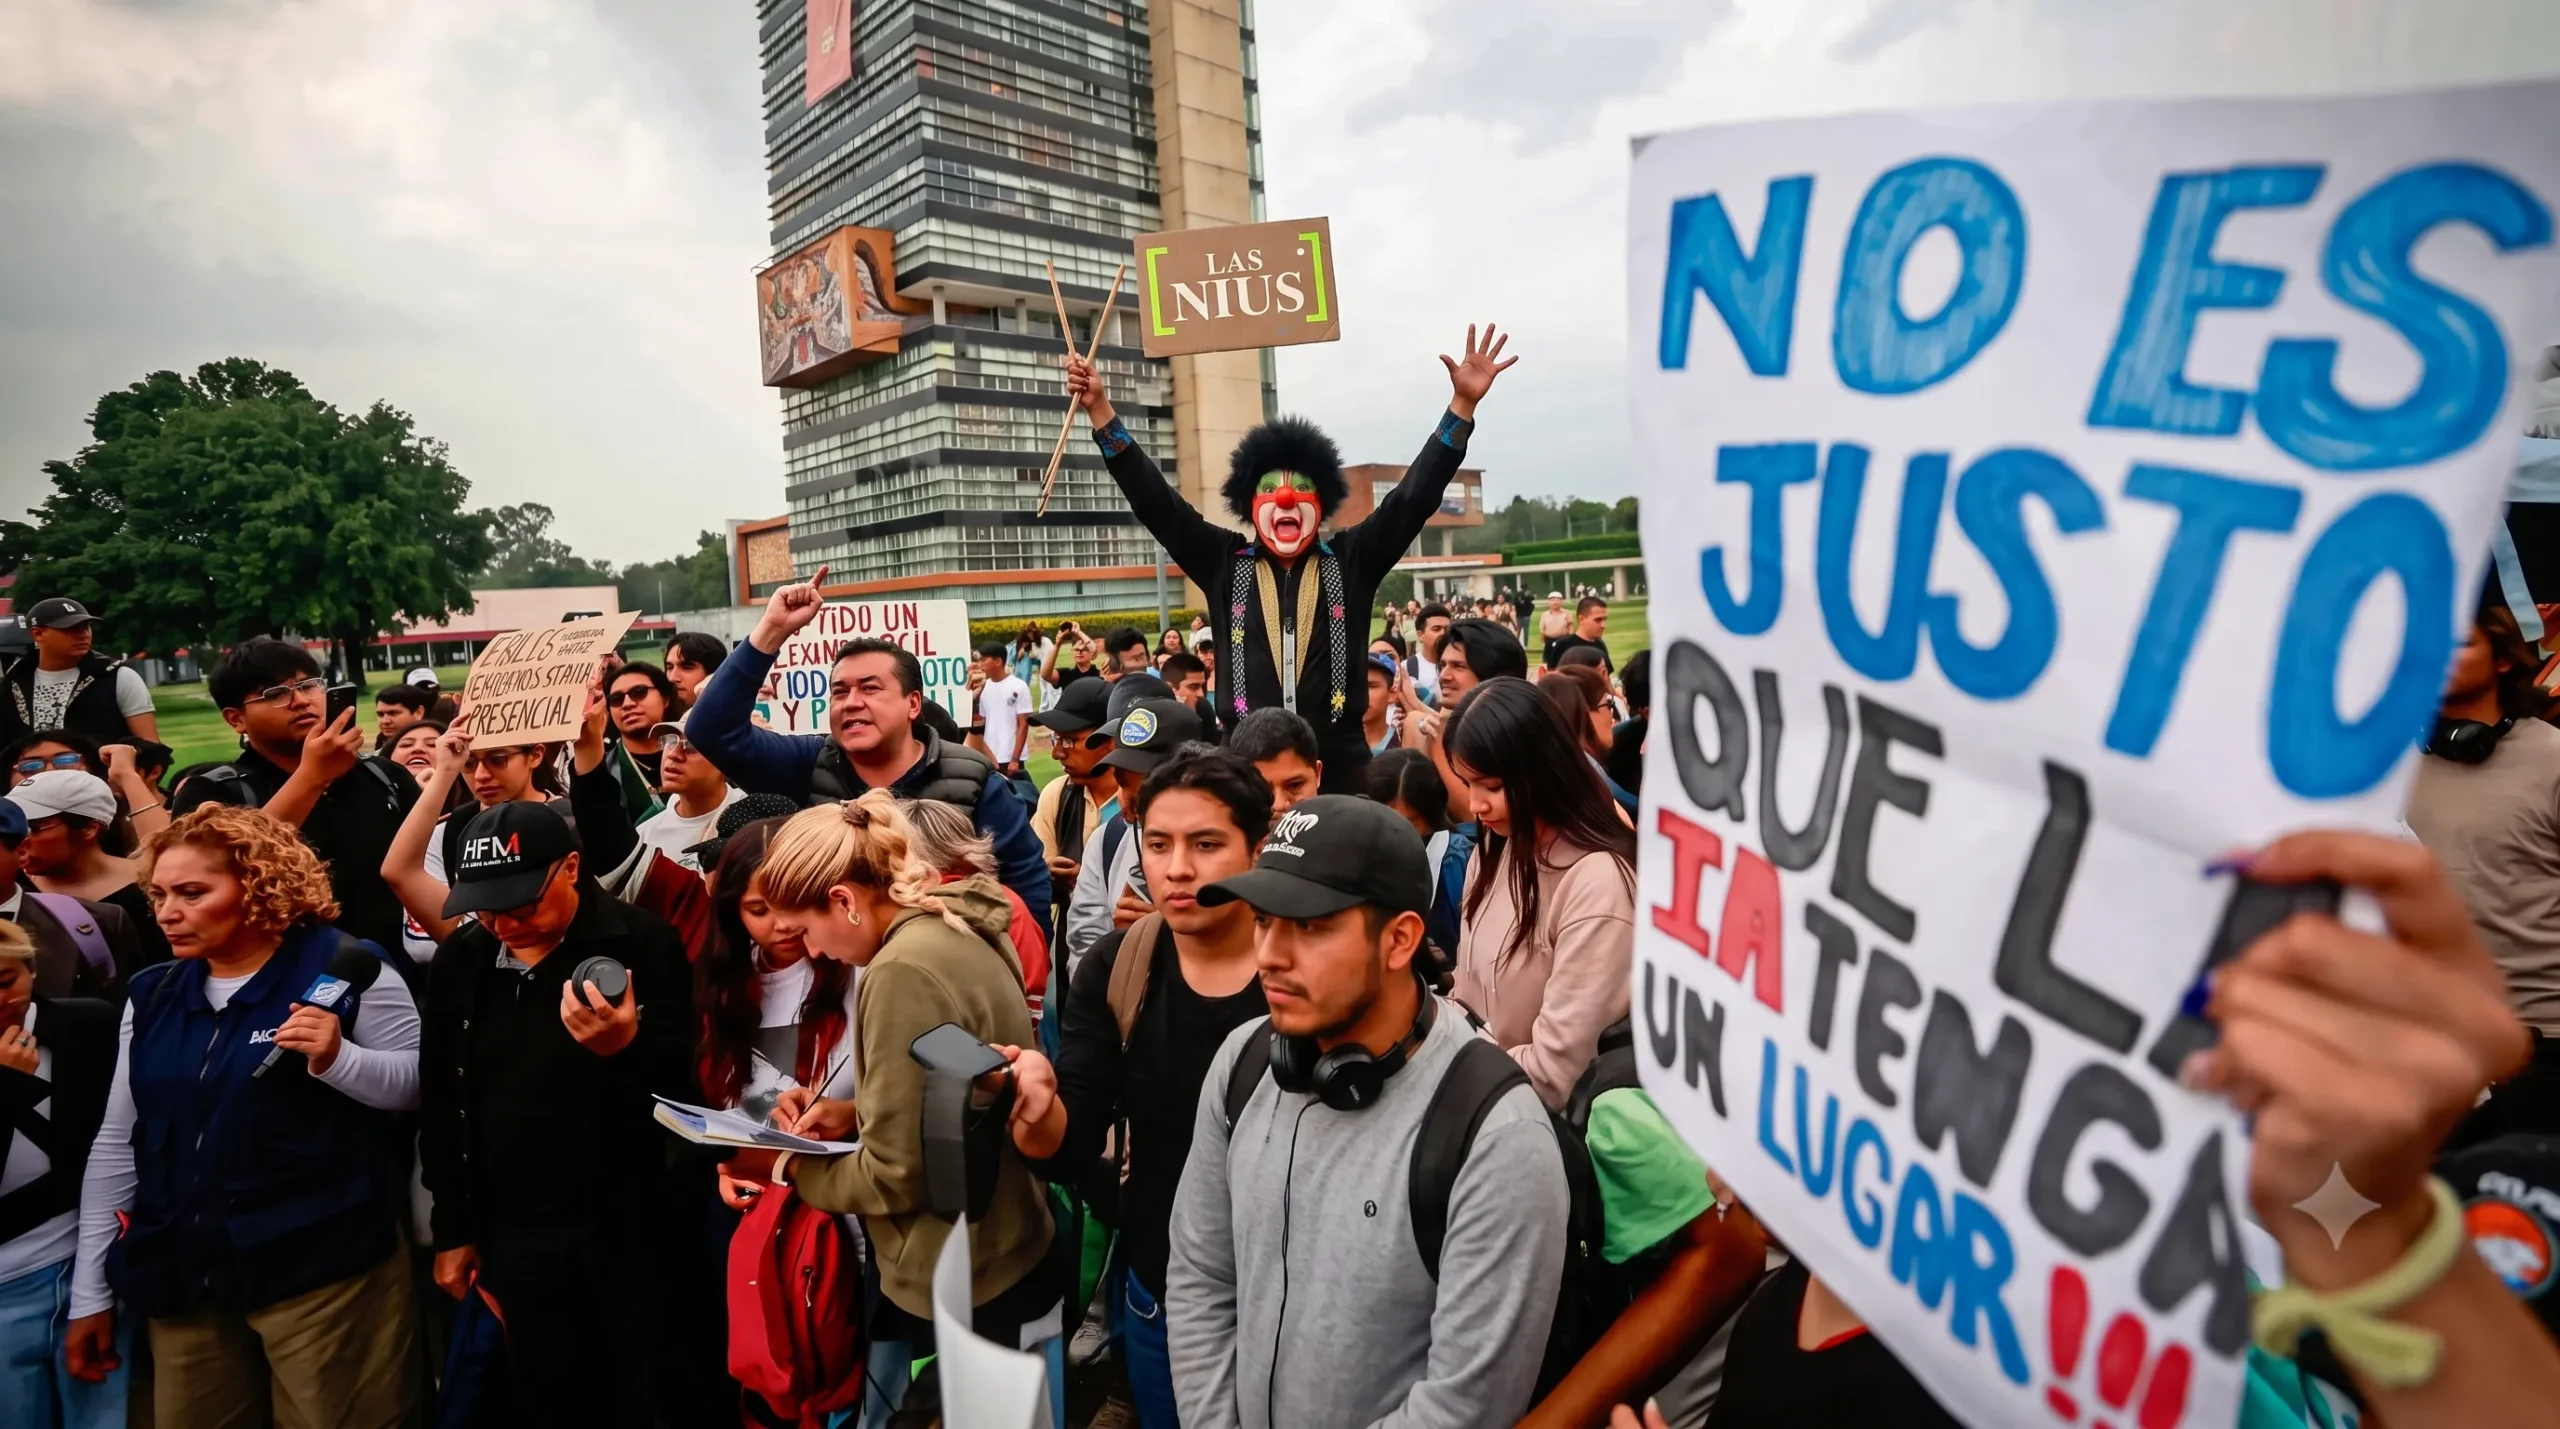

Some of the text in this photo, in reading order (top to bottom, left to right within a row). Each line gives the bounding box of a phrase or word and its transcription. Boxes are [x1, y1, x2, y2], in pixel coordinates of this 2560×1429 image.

[1205, 249, 1264, 275] LAS
[1170, 271, 1305, 322] NIUS
[1658, 154, 2555, 473] NO ES
[793, 603, 918, 637] TIDO UN
[1699, 441, 2458, 799] JUSTO
[466, 694, 572, 737] PRESENCIAL
[782, 700, 800, 731] Y
[1665, 640, 1945, 943] QUE
[463, 832, 521, 861] HFM
[1645, 961, 1728, 1119] UN
[1652, 806, 2249, 1358] IA TENGA
